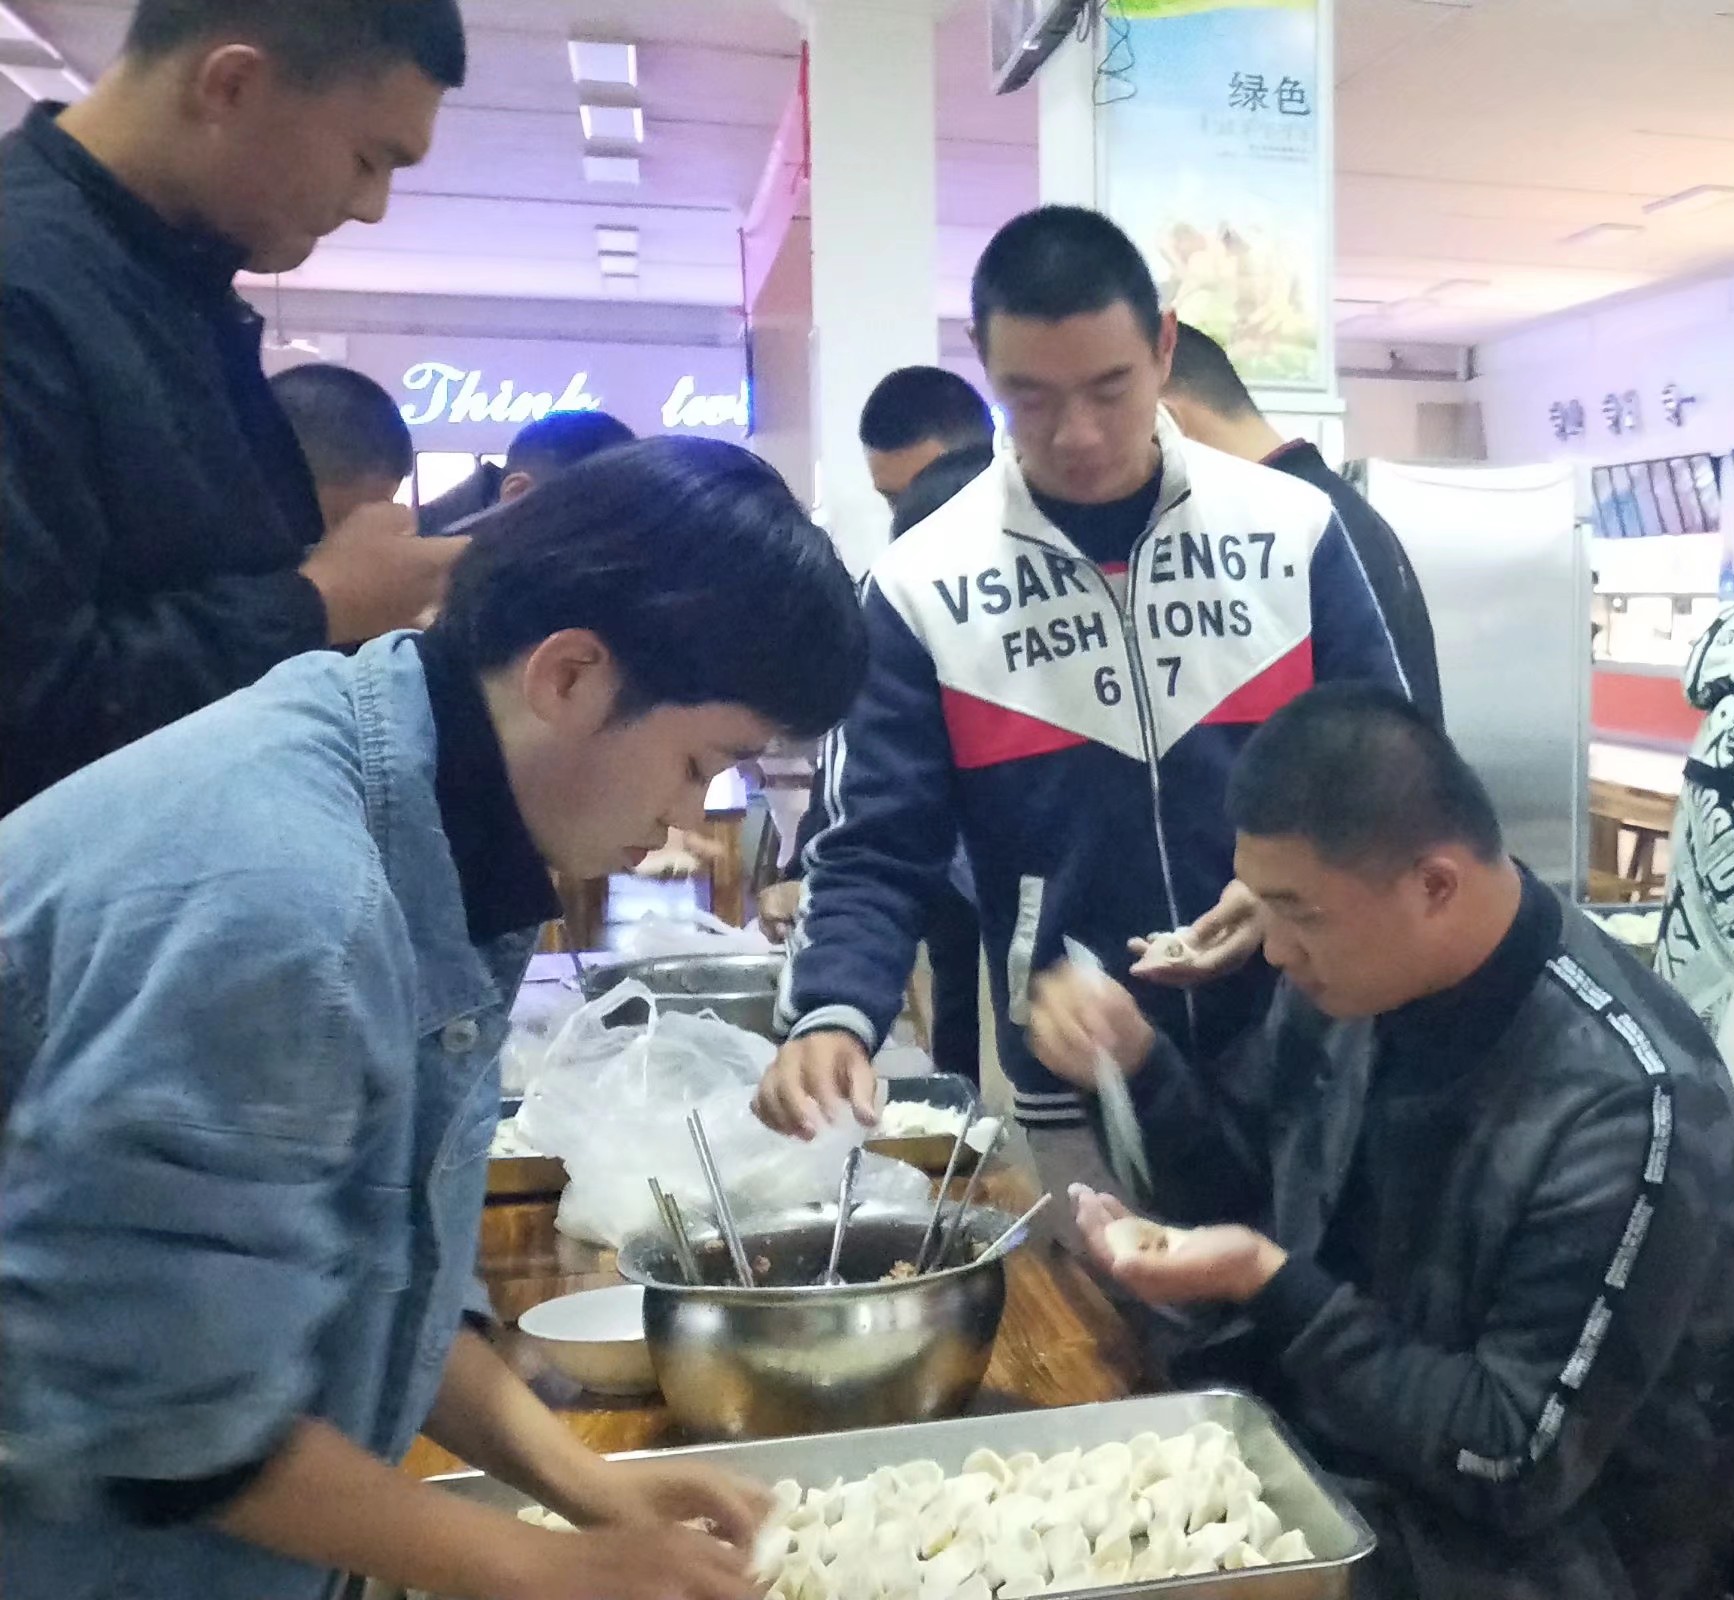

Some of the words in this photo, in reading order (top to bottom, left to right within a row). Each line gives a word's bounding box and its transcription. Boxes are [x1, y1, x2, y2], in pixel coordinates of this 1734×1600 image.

[1228, 71, 1312, 116] 绿色
[1002, 611, 1109, 673] FASH
[1147, 600, 1253, 640] IONS
[1093, 665, 1122, 706] 6
[1156, 657, 1183, 697] 7
